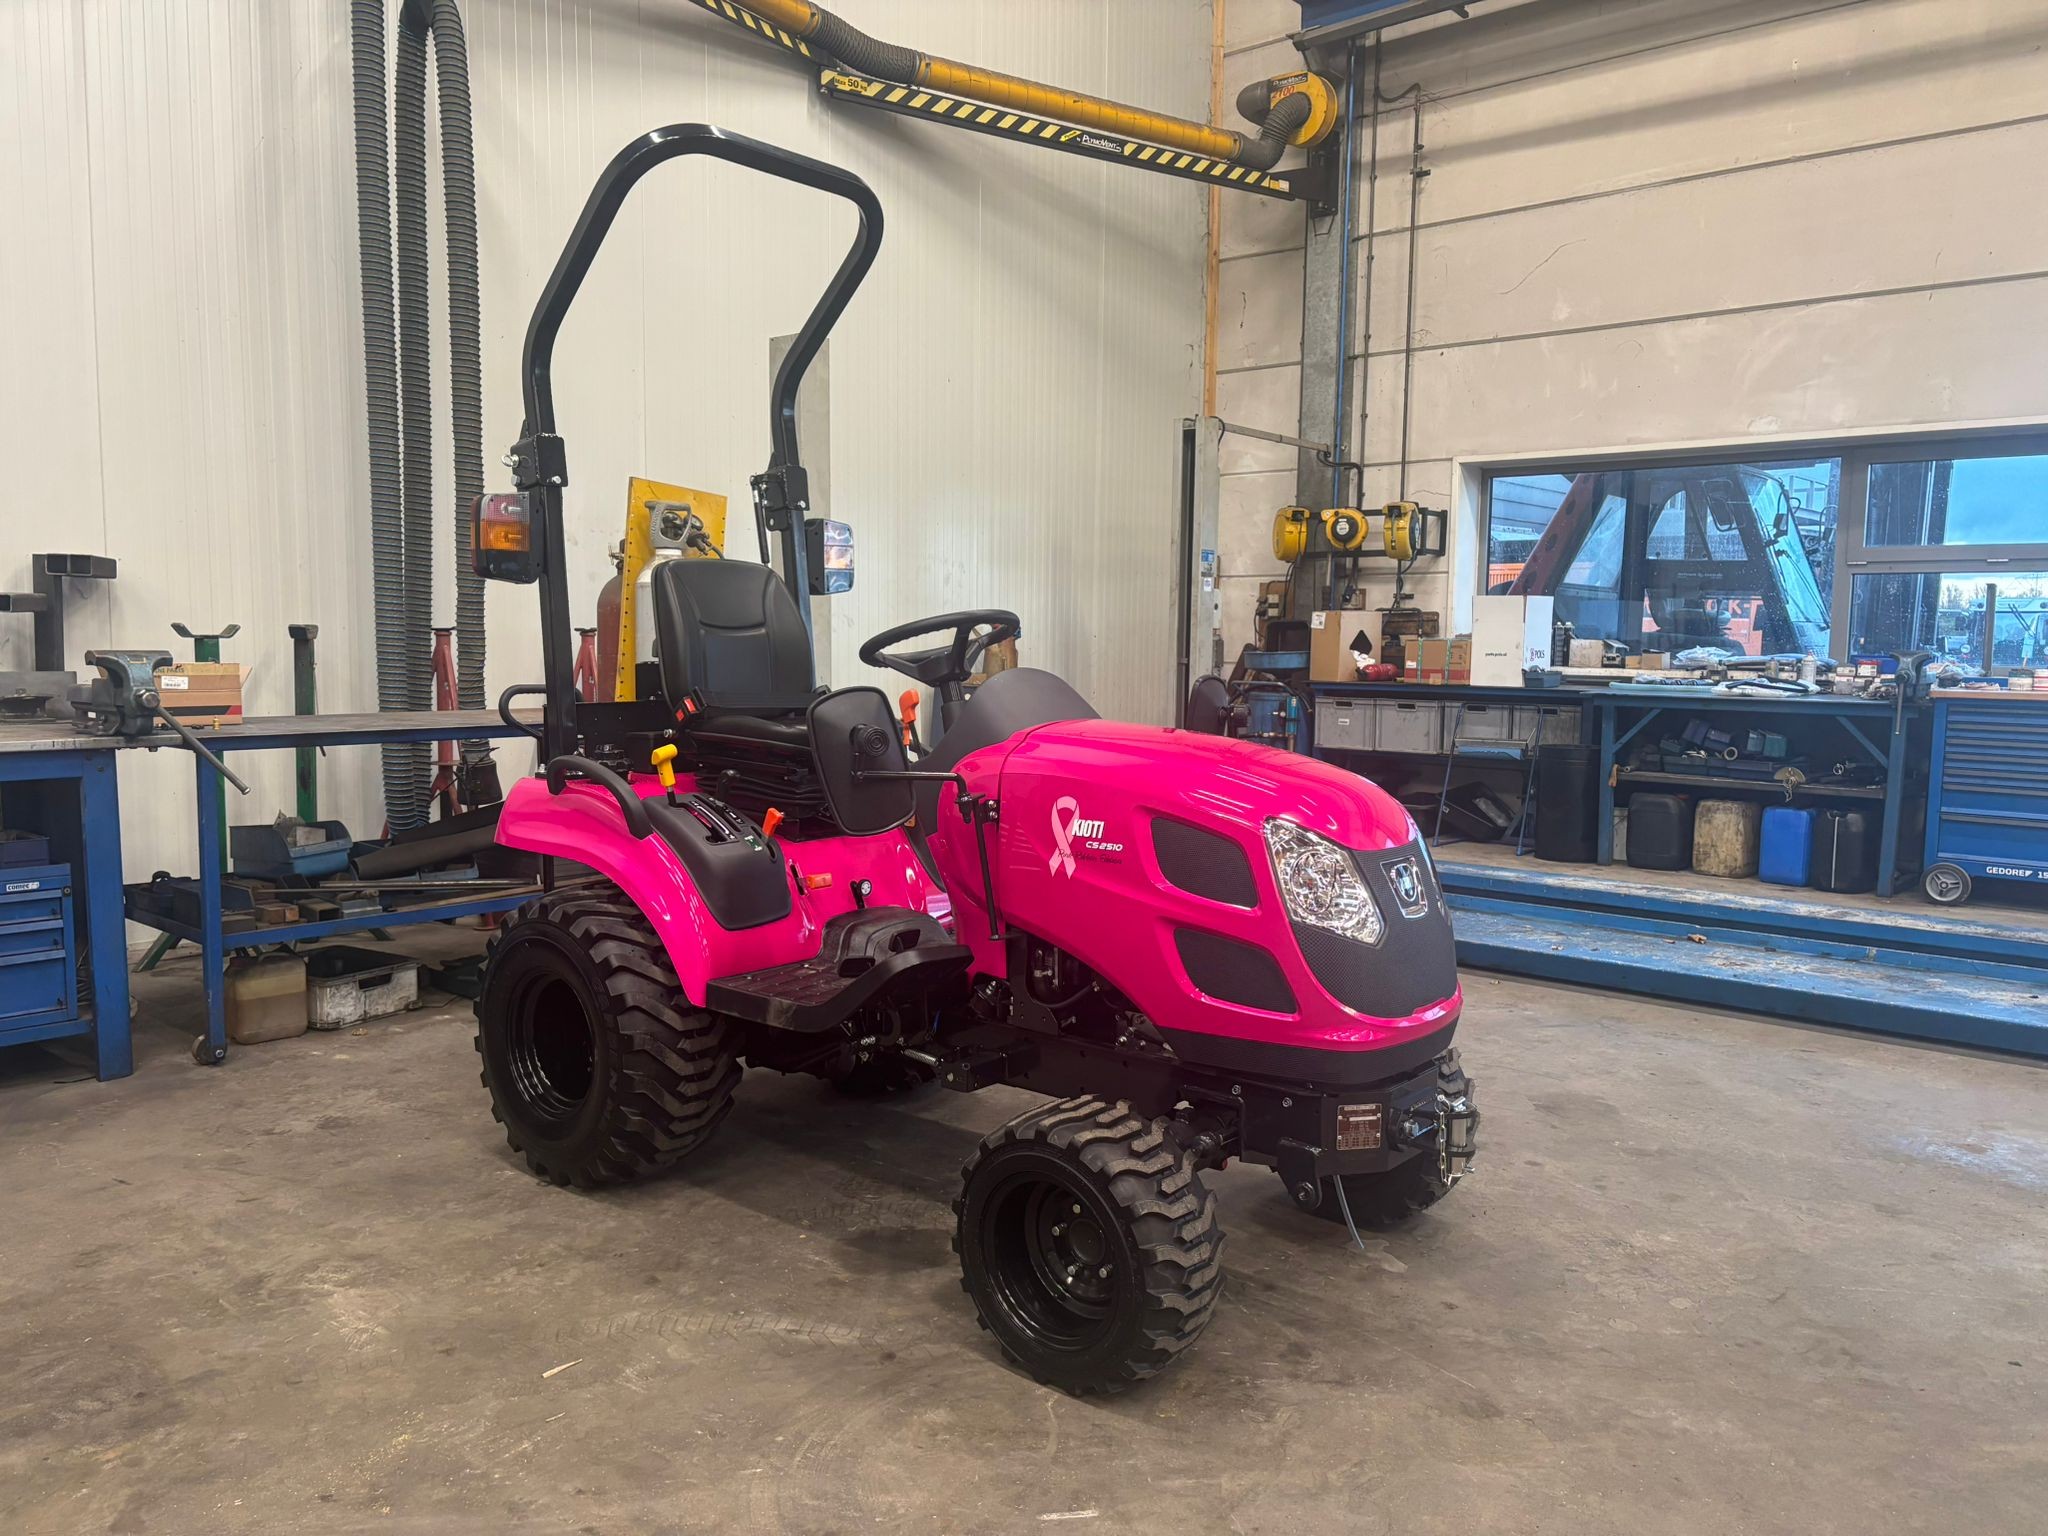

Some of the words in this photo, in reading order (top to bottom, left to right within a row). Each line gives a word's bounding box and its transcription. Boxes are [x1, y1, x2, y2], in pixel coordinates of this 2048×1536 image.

[847, 78, 859, 89] 50
[1072, 819, 1105, 839] KIOTI
[1986, 866, 2025, 877] GEDORE
